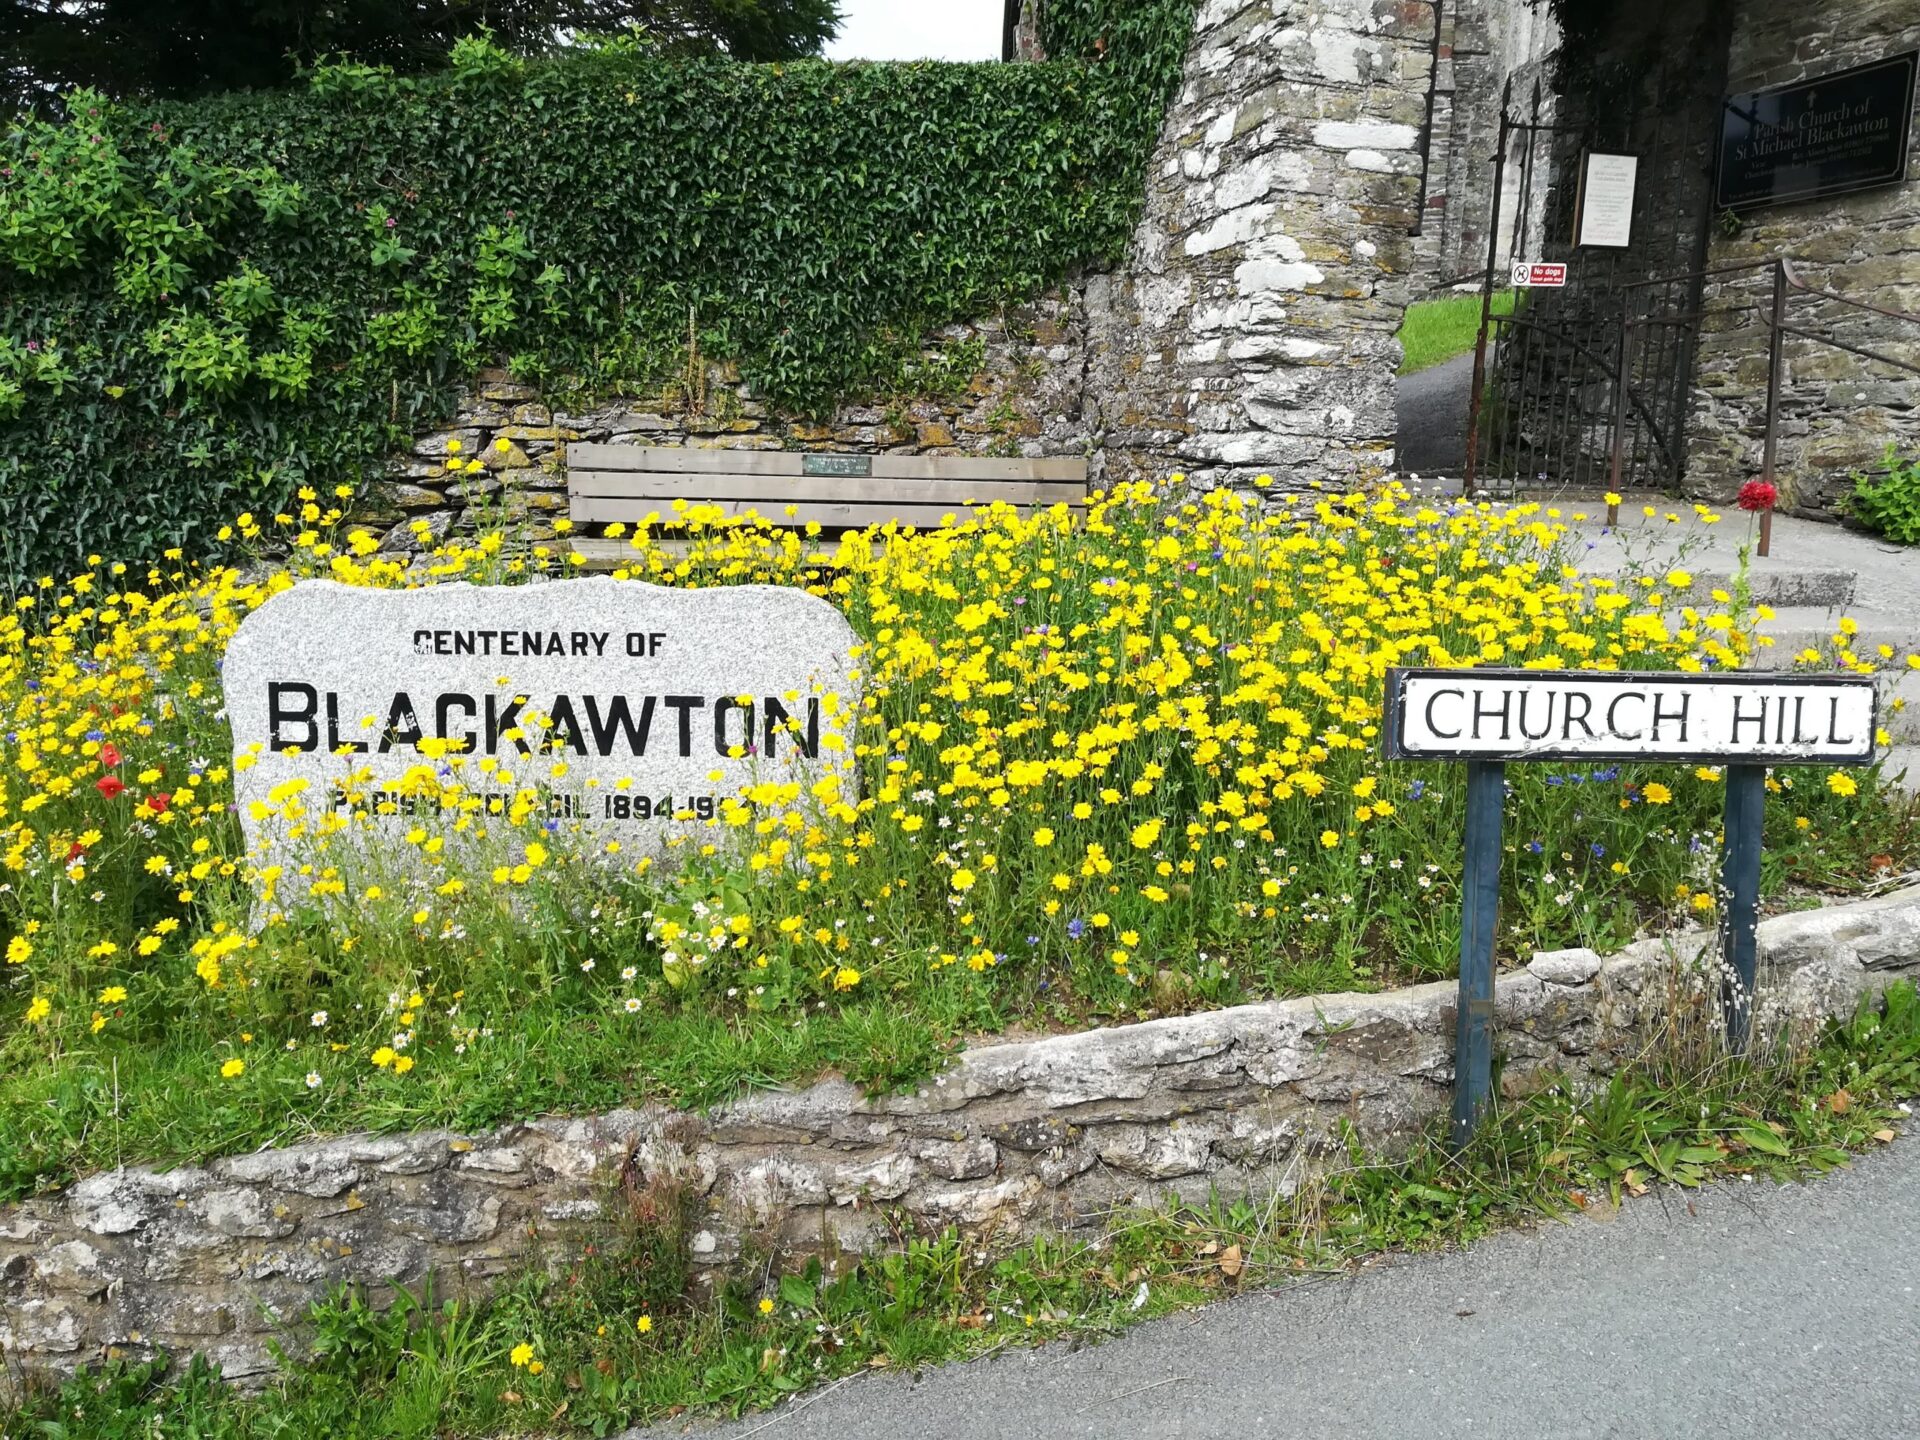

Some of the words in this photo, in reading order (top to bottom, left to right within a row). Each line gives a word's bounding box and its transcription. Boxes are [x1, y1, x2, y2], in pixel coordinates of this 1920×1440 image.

[1735, 143, 1748, 161] St
[1751, 131, 1803, 158] Michael
[1807, 116, 1889, 146] Blackawton
[1754, 116, 1794, 139] Parish
[1799, 103, 1850, 129] Church
[1855, 97, 1872, 115] of
[1534, 267, 1544, 275] No
[1545, 268, 1561, 276] dogs
[413, 630, 609, 657] CENTENARY
[626, 632, 666, 657] OF
[268, 682, 819, 758] BLACKAWTON
[1424, 688, 1692, 743] CHURCH
[1730, 694, 1855, 746] HILL
[333, 790, 441, 816] PRISH
[605, 794, 758, 820] 1894-19
